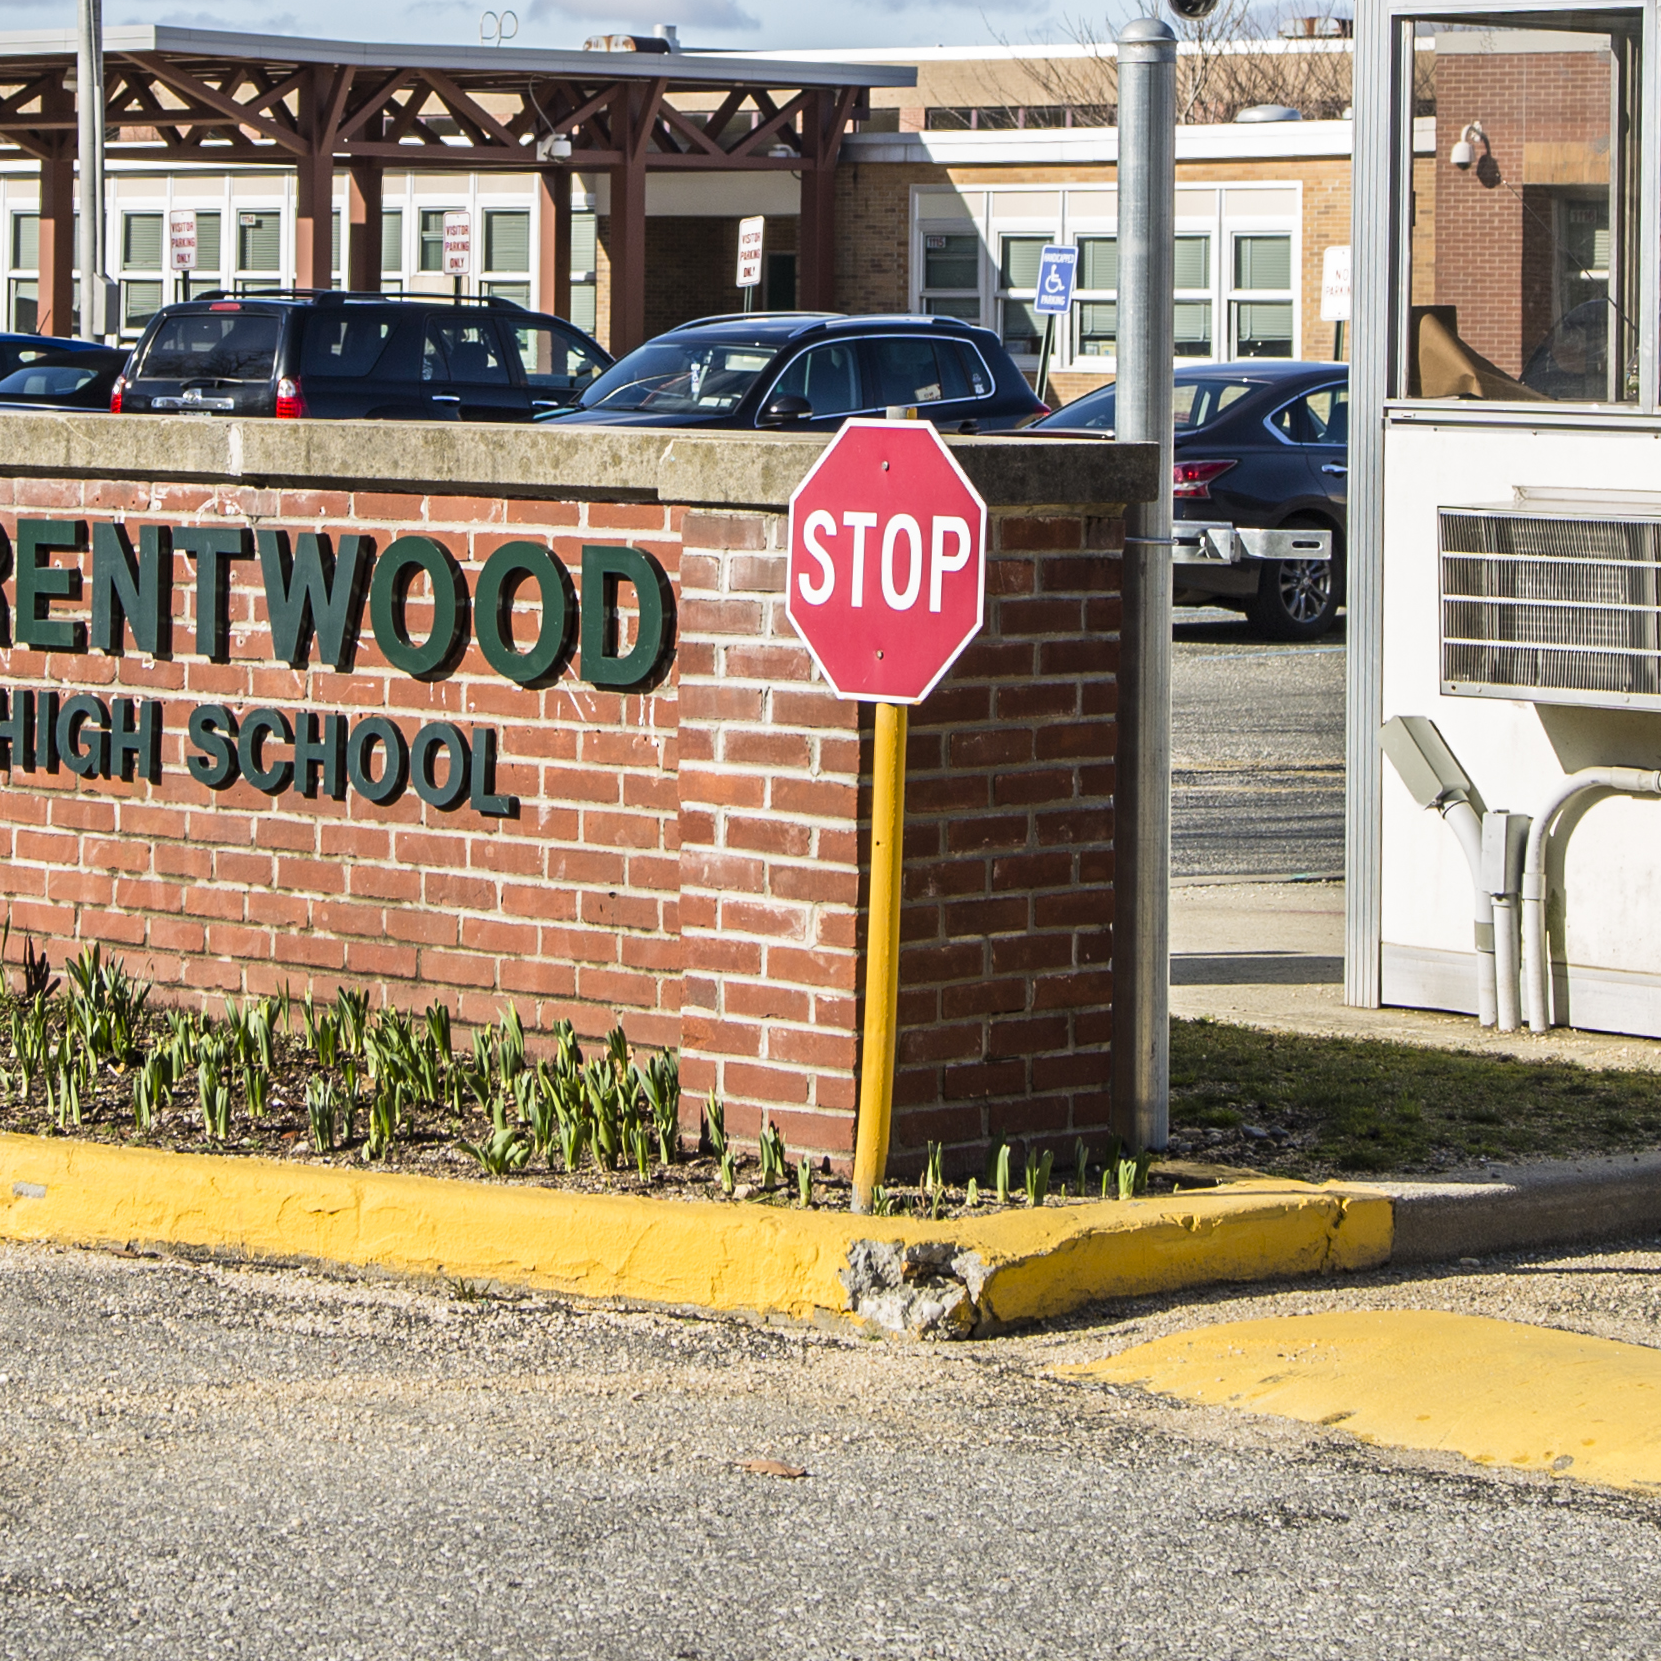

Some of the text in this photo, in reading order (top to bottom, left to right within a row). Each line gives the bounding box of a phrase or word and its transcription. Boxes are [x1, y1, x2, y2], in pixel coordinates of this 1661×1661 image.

[171, 222, 194, 233] VISITOR
[445, 225, 469, 236] VISITOR
[171, 237, 195, 248] PARKING
[742, 232, 761, 244] VISITOR
[445, 241, 469, 252] PARKING
[176, 253, 191, 264] ONLY
[740, 249, 761, 261] PARKING
[1043, 253, 1075, 264] HANDICAPPED
[449, 257, 465, 269] ONLY
[743, 266, 756, 278] ONLY
[1335, 268, 1349, 282] NO
[1040, 295, 1066, 306] PARKING
[798, 509, 972, 613] STOP
[187, 704, 513, 817] SCHOOL
